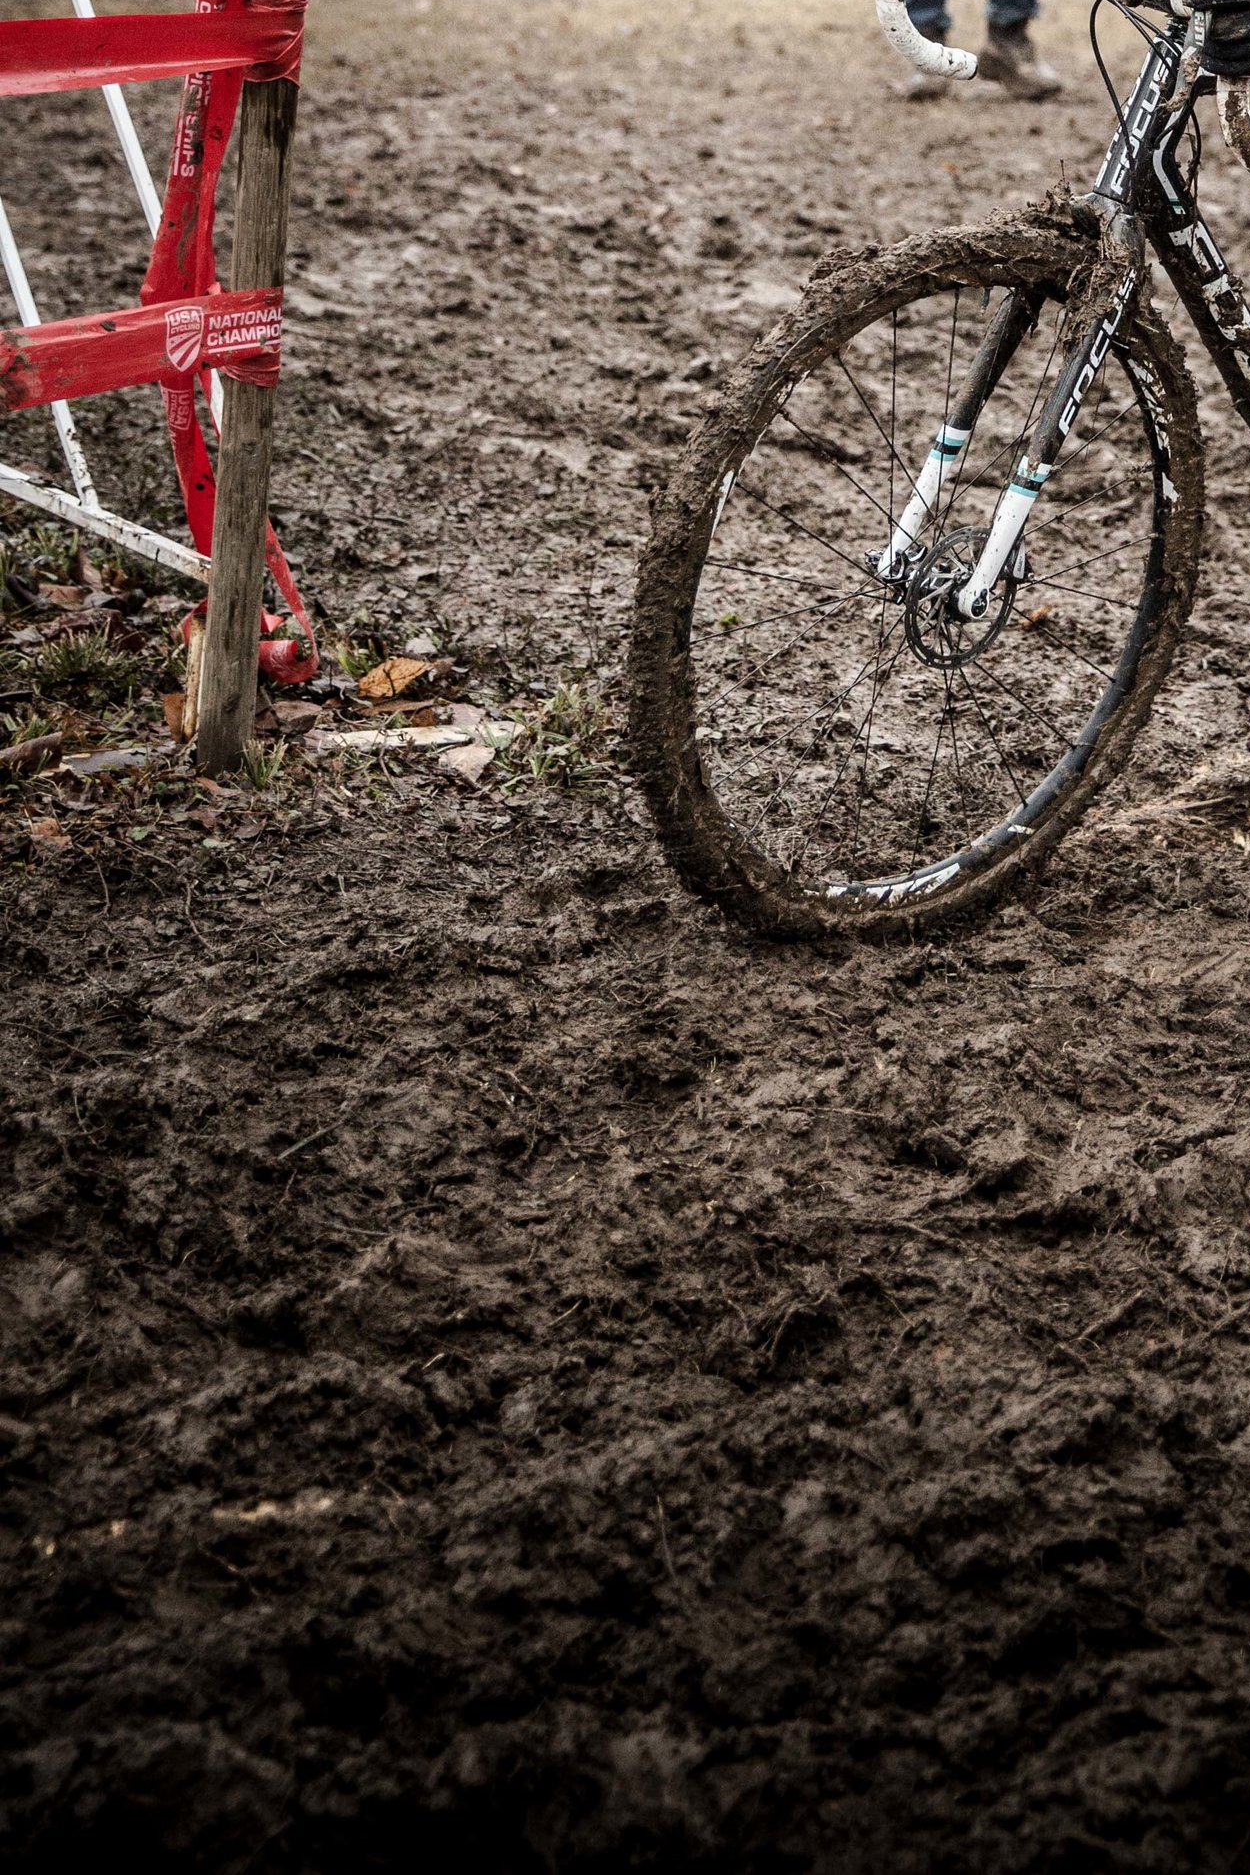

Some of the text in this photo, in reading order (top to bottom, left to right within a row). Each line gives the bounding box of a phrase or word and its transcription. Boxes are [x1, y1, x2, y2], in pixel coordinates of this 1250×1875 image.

[1110, 56, 1174, 196] FOCUS
[168, 310, 201, 327] USA
[170, 324, 201, 335] CYCLING
[208, 307, 283, 330] NATIONAL
[1058, 267, 1137, 436] FOCUS
